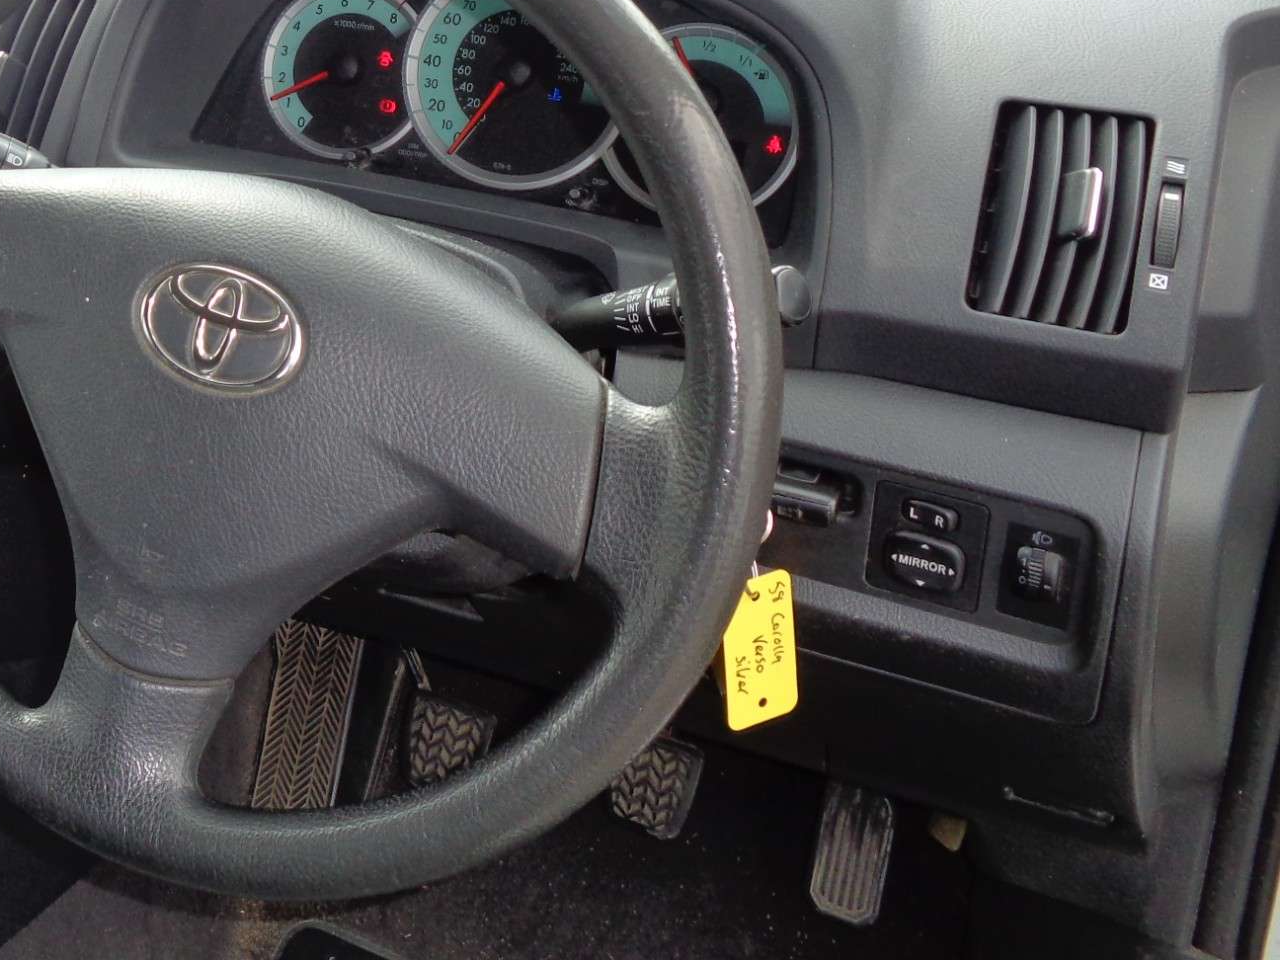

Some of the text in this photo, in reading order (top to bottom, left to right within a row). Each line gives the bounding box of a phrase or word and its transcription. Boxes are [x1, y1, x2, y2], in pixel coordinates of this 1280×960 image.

[315, 5, 323, 15] 5
[368, 0, 375, 10] 7
[463, 0, 476, 11] 70
[390, 14, 397, 24] 8
[443, 13, 461, 25] 60
[500, 16, 517, 26] 140
[293, 20, 301, 31] 4
[484, 23, 499, 34] 120
[433, 33, 447, 45] 50
[471, 34, 486, 45] 100
[281, 46, 288, 56] 3
[461, 49, 475, 59] 80
[424, 55, 441, 67] 40
[457, 65, 471, 76] 60
[278, 72, 285, 82] 2
[424, 78, 438, 89] 30
[459, 82, 473, 92] 40
[428, 98, 445, 112] 20
[467, 98, 480, 108] 20
[297, 117, 305, 128] 0
[441, 119, 452, 130] 10
[653, 296, 671, 308] TIME
[627, 303, 639, 313] INT
[628, 313, 639, 323] LO
[632, 325, 644, 334] HI
[909, 506, 919, 520] L
[934, 515, 944, 528] R
[898, 553, 947, 575] MIRROR
